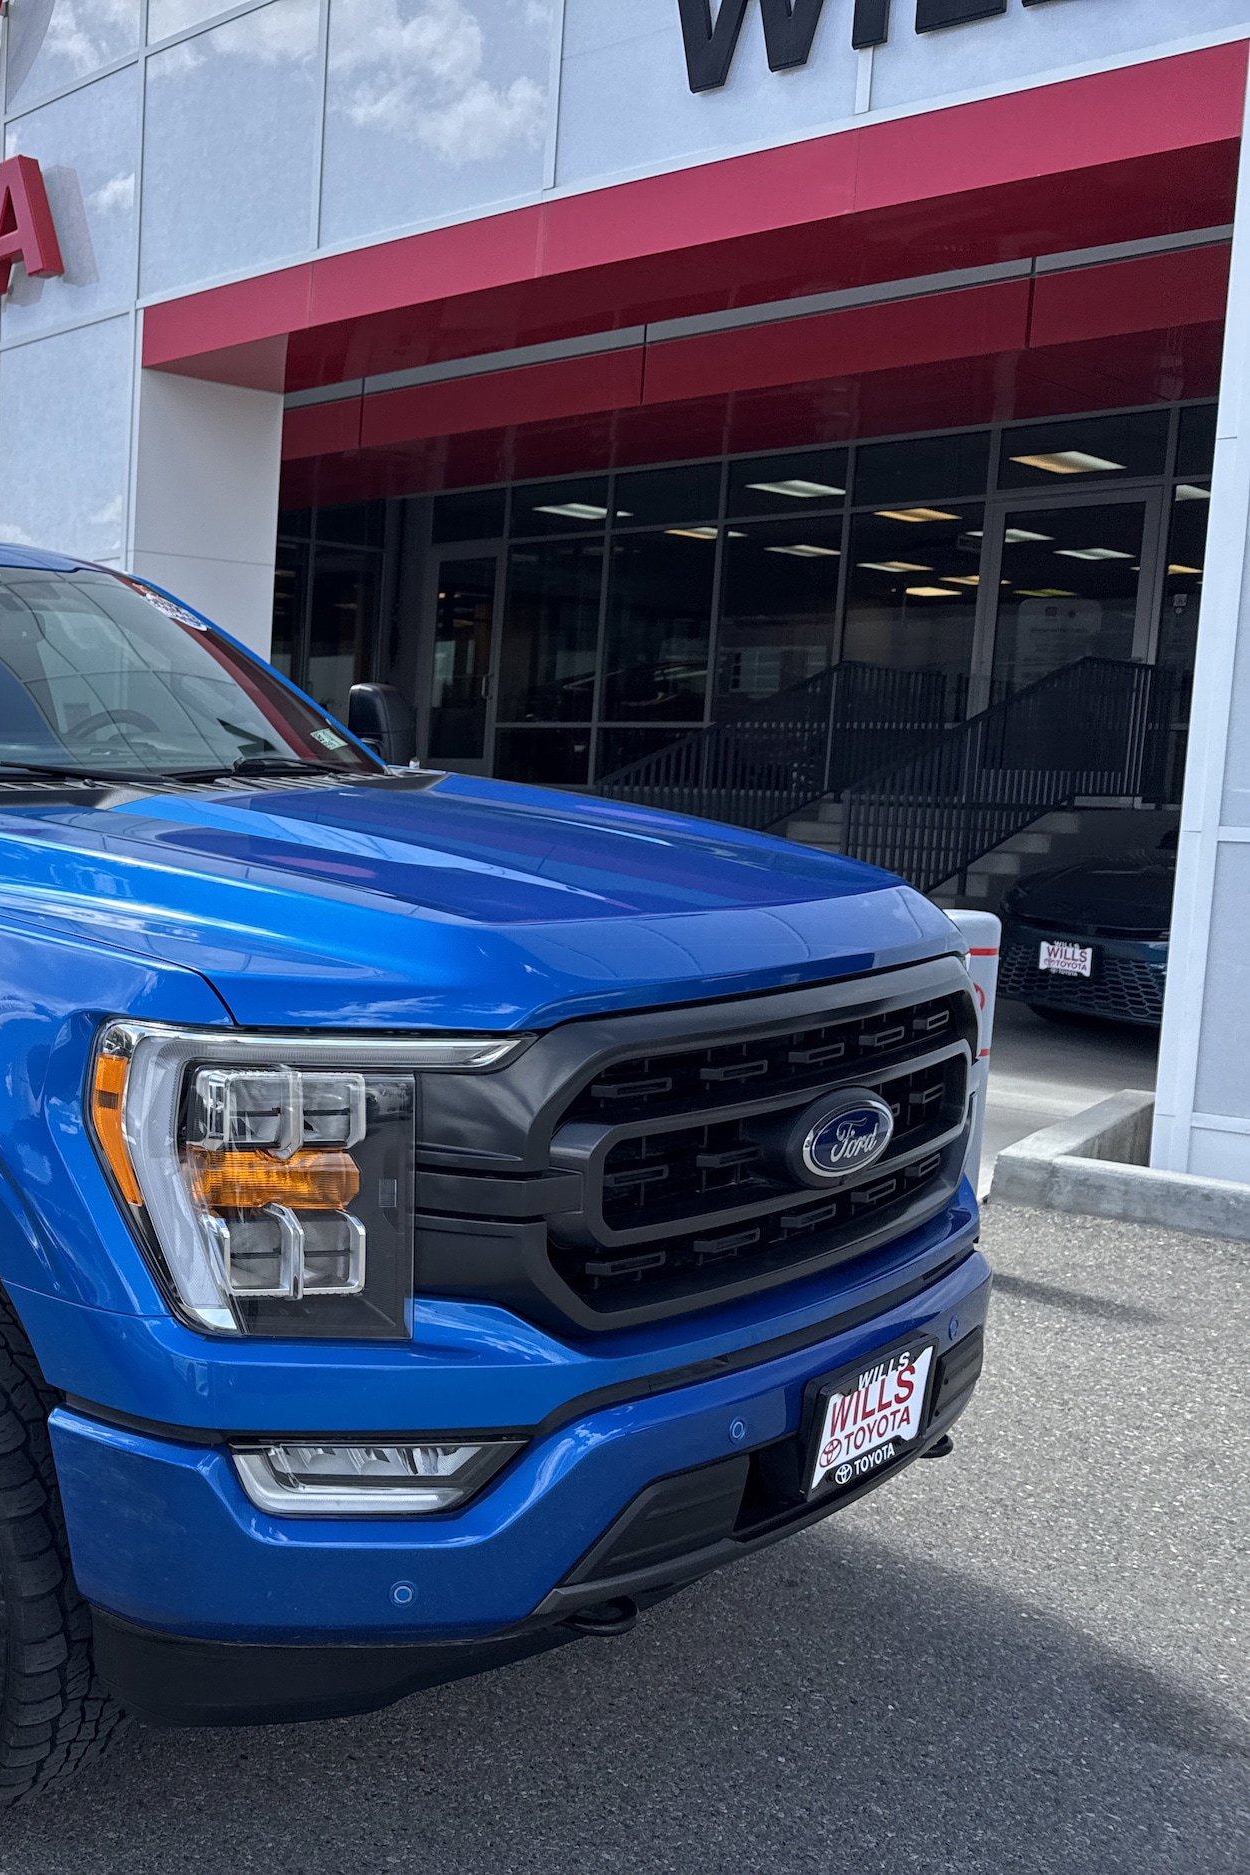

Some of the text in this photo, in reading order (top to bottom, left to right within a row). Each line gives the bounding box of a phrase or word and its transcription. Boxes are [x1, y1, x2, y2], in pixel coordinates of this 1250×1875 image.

[1047, 945, 1087, 963] WILLS
[1056, 960, 1087, 971] TOYOTA
[831, 1117, 878, 1162] Ford
[858, 1352, 910, 1390] WILLS
[830, 1364, 915, 1437] WILLS
[844, 1406, 910, 1455] TOYOTA
[854, 1442, 895, 1475] TOYOTA
